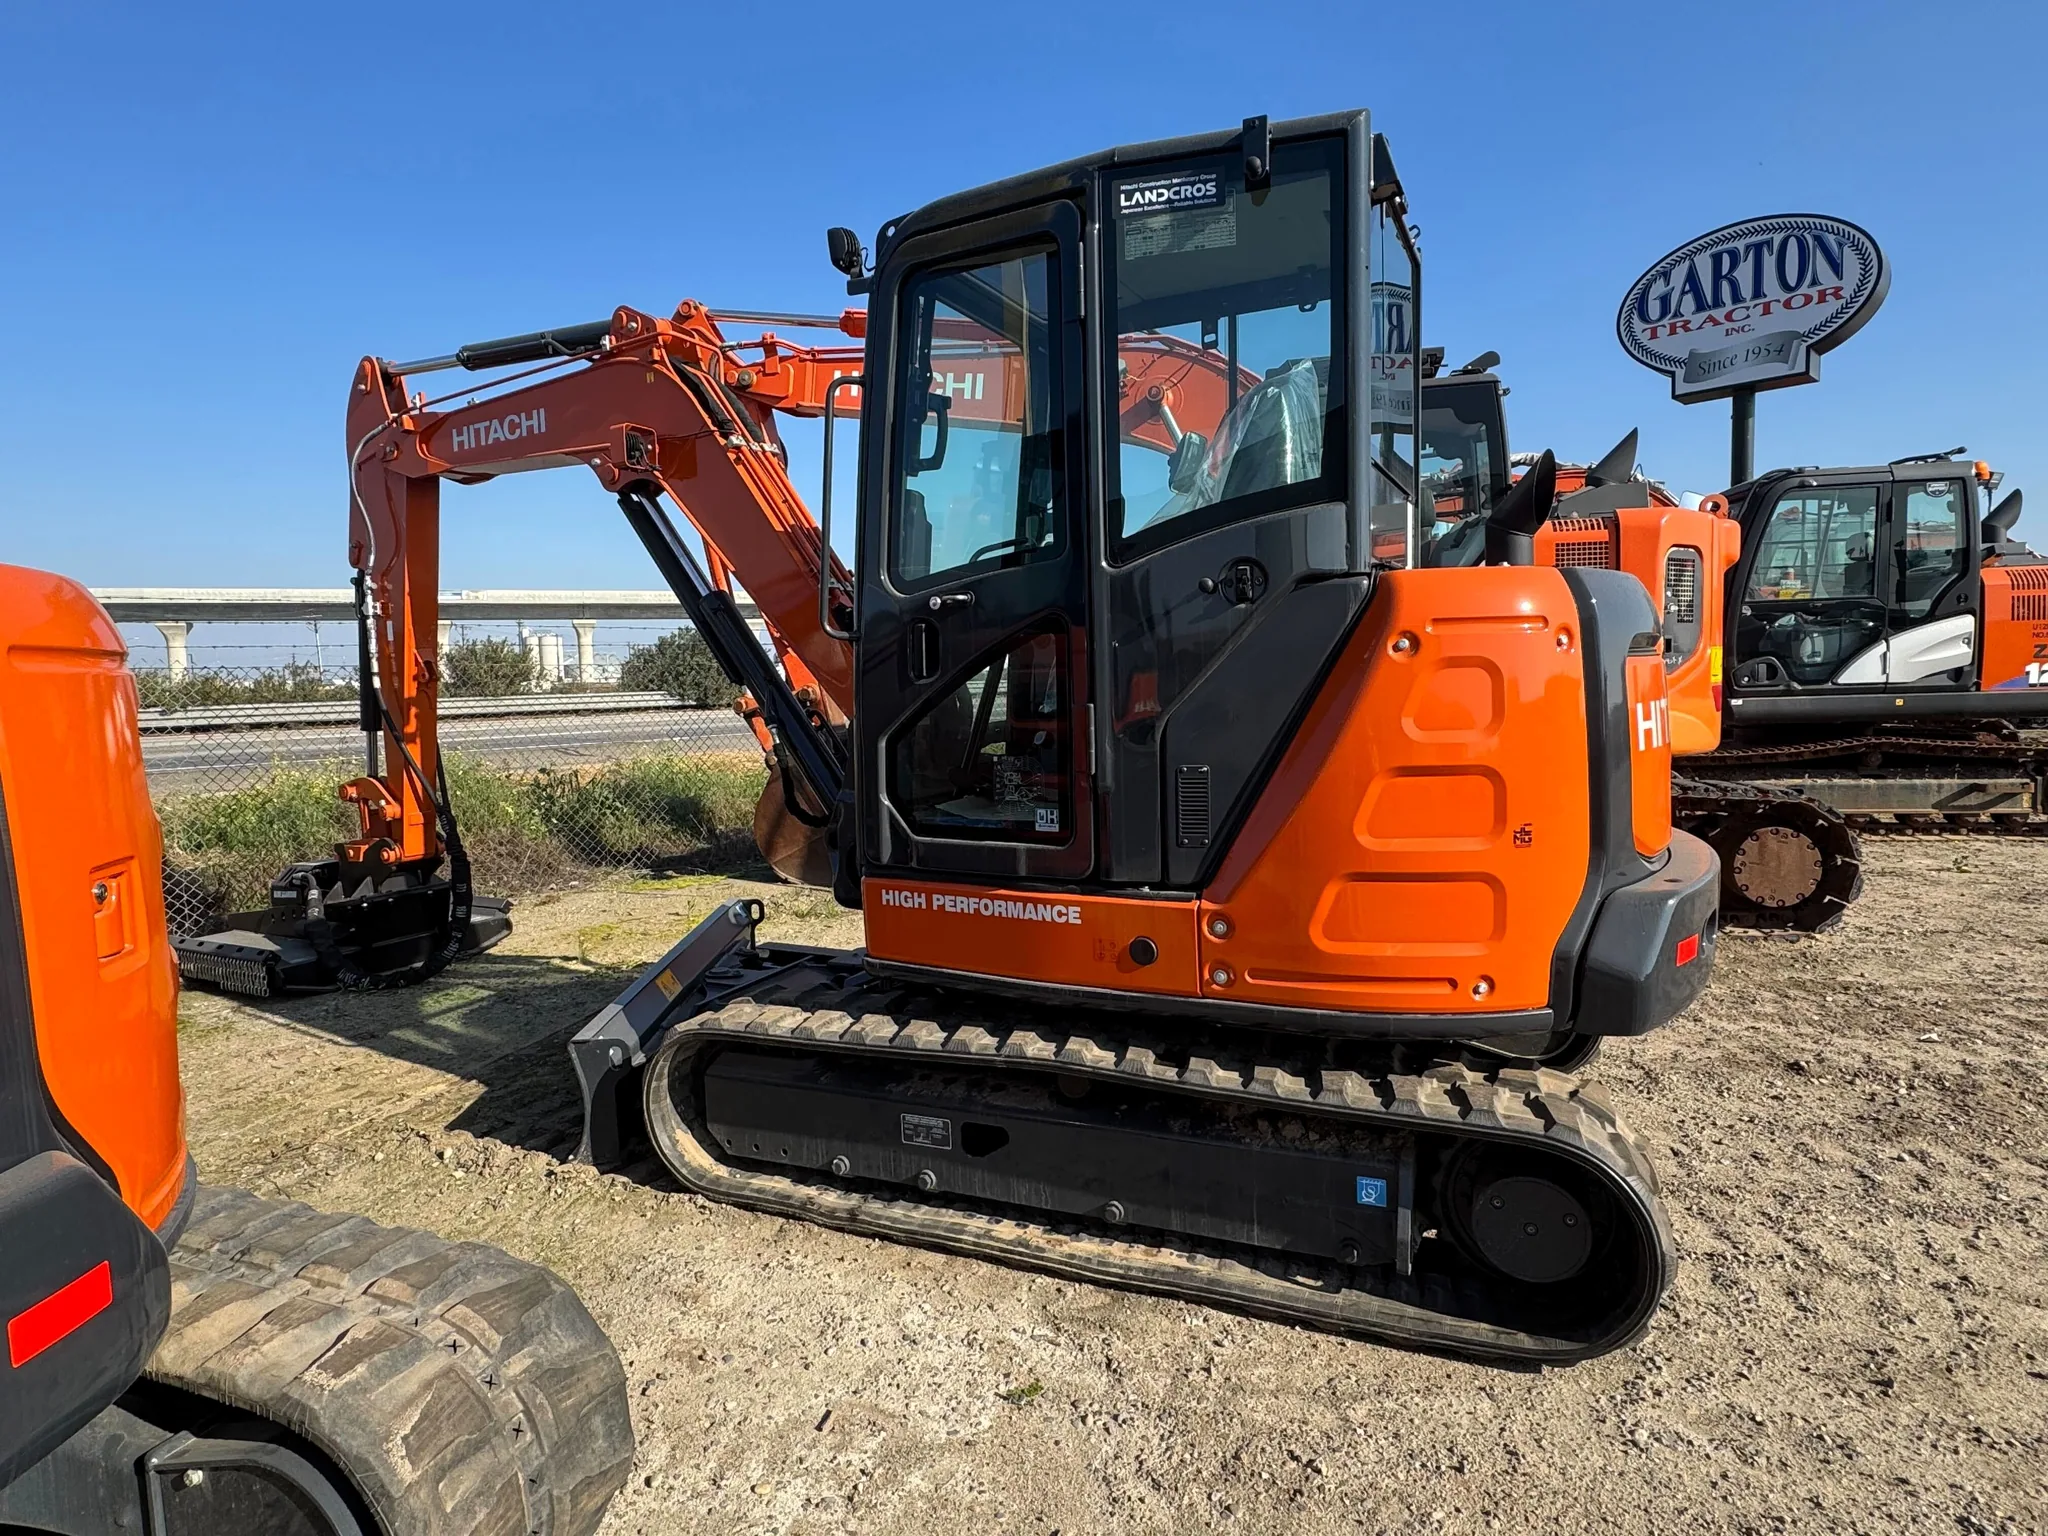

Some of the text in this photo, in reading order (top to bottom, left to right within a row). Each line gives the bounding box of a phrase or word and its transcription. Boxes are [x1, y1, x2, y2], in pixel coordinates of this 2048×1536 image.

[1120, 181, 1217, 207] LANDCROS
[1635, 231, 1851, 325] GARTON
[1641, 285, 1846, 340] TRACTOR
[1724, 324, 1755, 337] INC.
[1697, 342, 1785, 377] Since 1954
[452, 408, 546, 452] HITACHI
[881, 889, 1082, 925] HIGH PERFORMANCE
